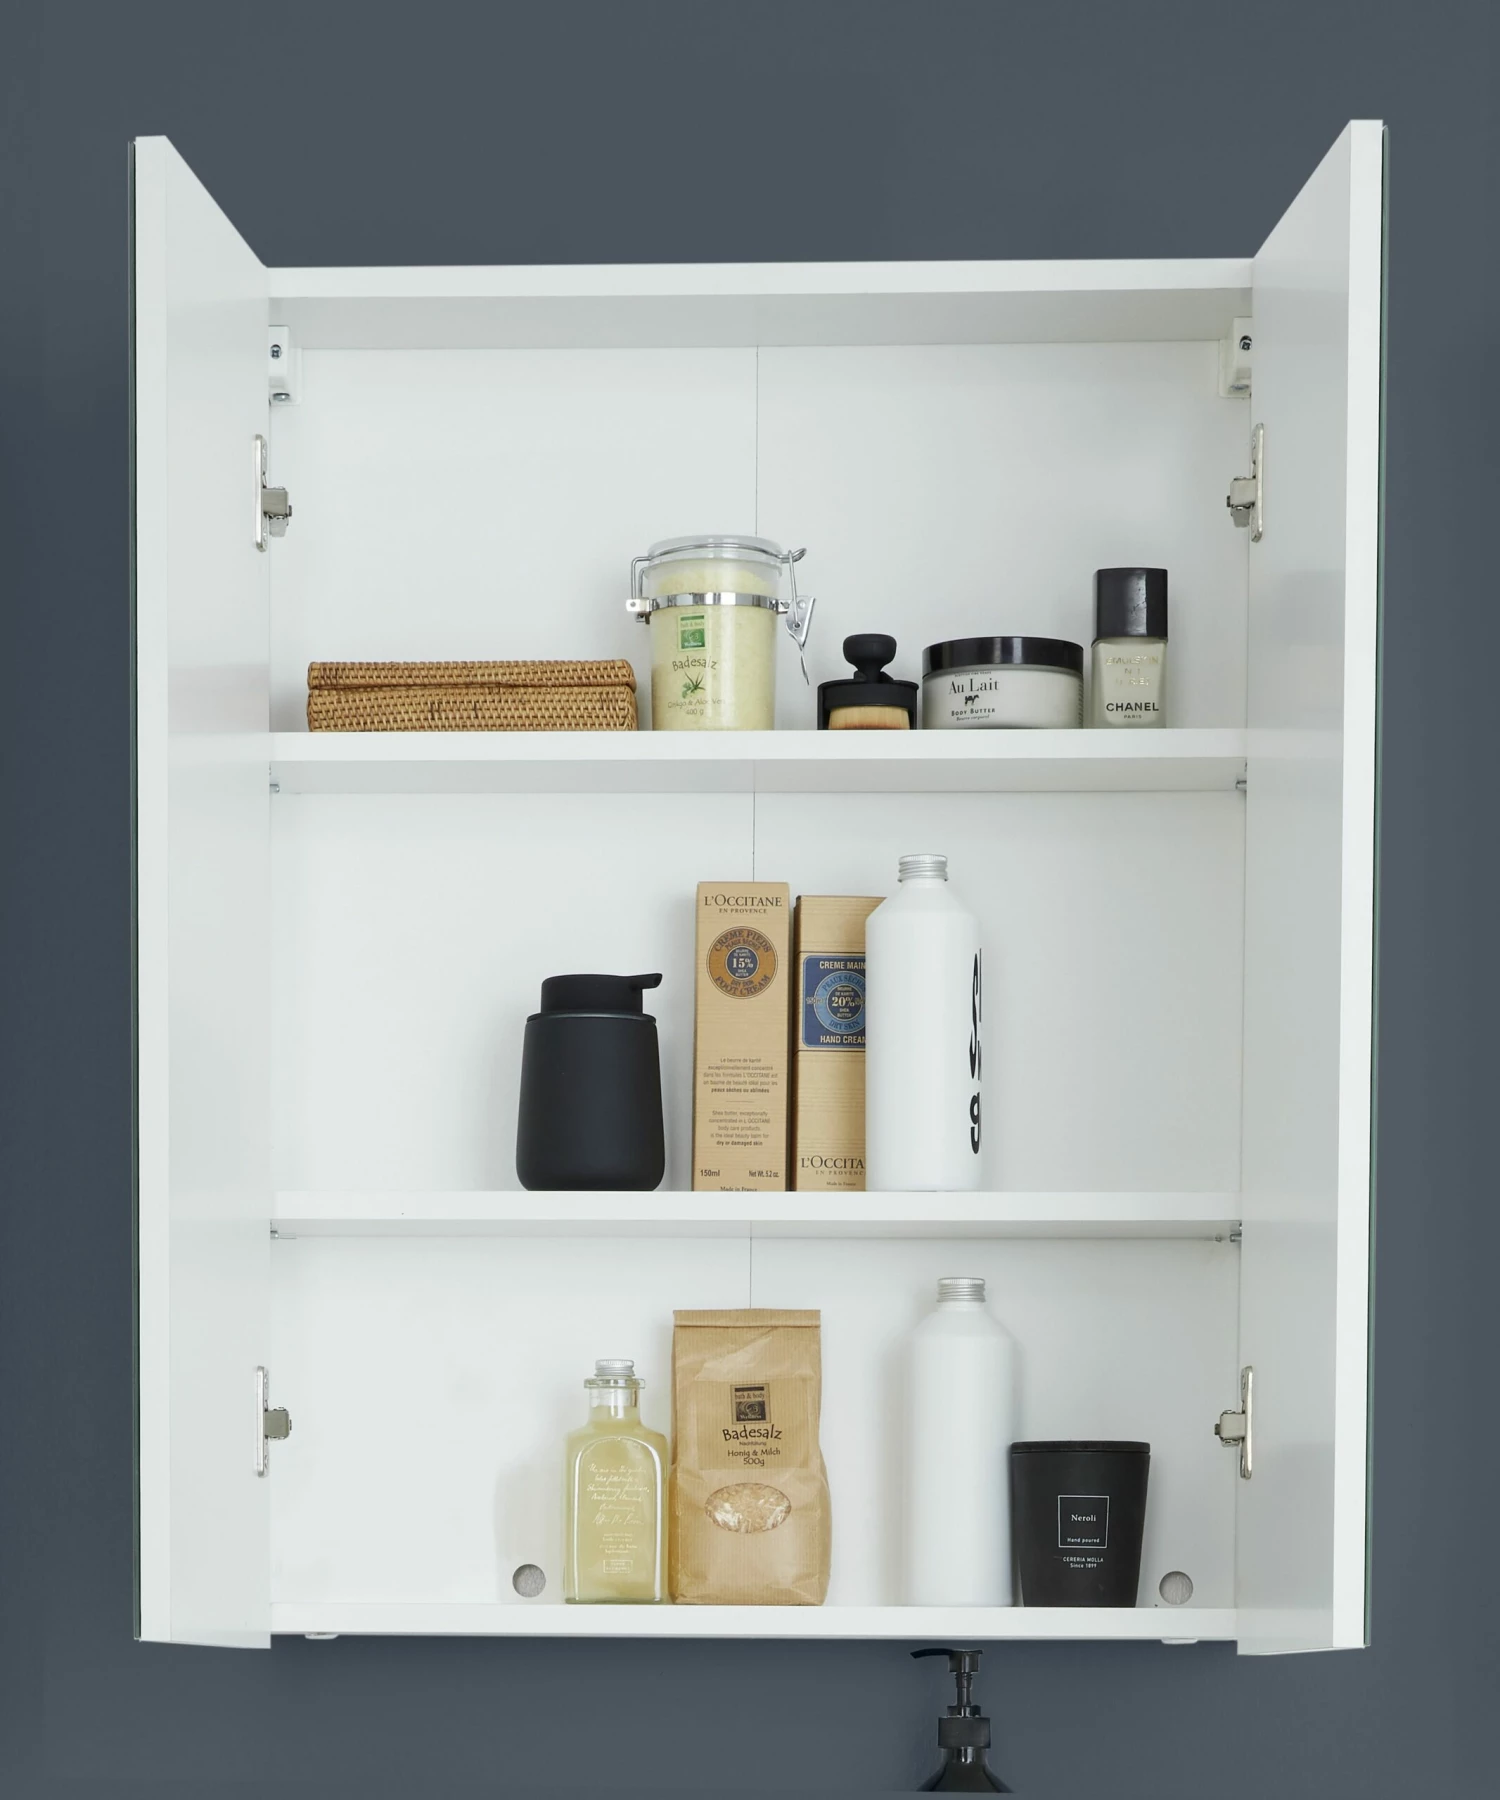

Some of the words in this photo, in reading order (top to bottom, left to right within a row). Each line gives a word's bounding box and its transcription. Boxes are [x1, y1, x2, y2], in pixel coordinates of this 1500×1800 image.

[672, 655, 718, 671] Badesalz
[948, 680, 965, 695] Au
[969, 677, 1000, 692] Lait
[1106, 702, 1160, 712] CHANEL
[704, 893, 783, 907] L'OCCITANE
[732, 958, 754, 969] 15%
[819, 961, 845, 970] CREME
[846, 961, 866, 970] MAIN
[715, 976, 738, 995] FOOT
[739, 974, 771, 995] CREAM
[822, 975, 844, 991] PEAUX
[844, 975, 866, 990] SECHE
[831, 996, 855, 1007] 20%
[829, 1019, 843, 1031] DRY
[843, 1018, 860, 1031] SKIN
[820, 1035, 841, 1044] HAND
[801, 1155, 865, 1169] L'OCCITA
[700, 1169, 720, 1177] 150ml
[722, 1424, 782, 1441] Badesalz
[727, 1449, 750, 1458] Honig
[751, 1449, 758, 1457] &
[760, 1447, 781, 1456] Milch
[743, 1457, 765, 1467] 500g
[1071, 1514, 1097, 1522] Neroli
